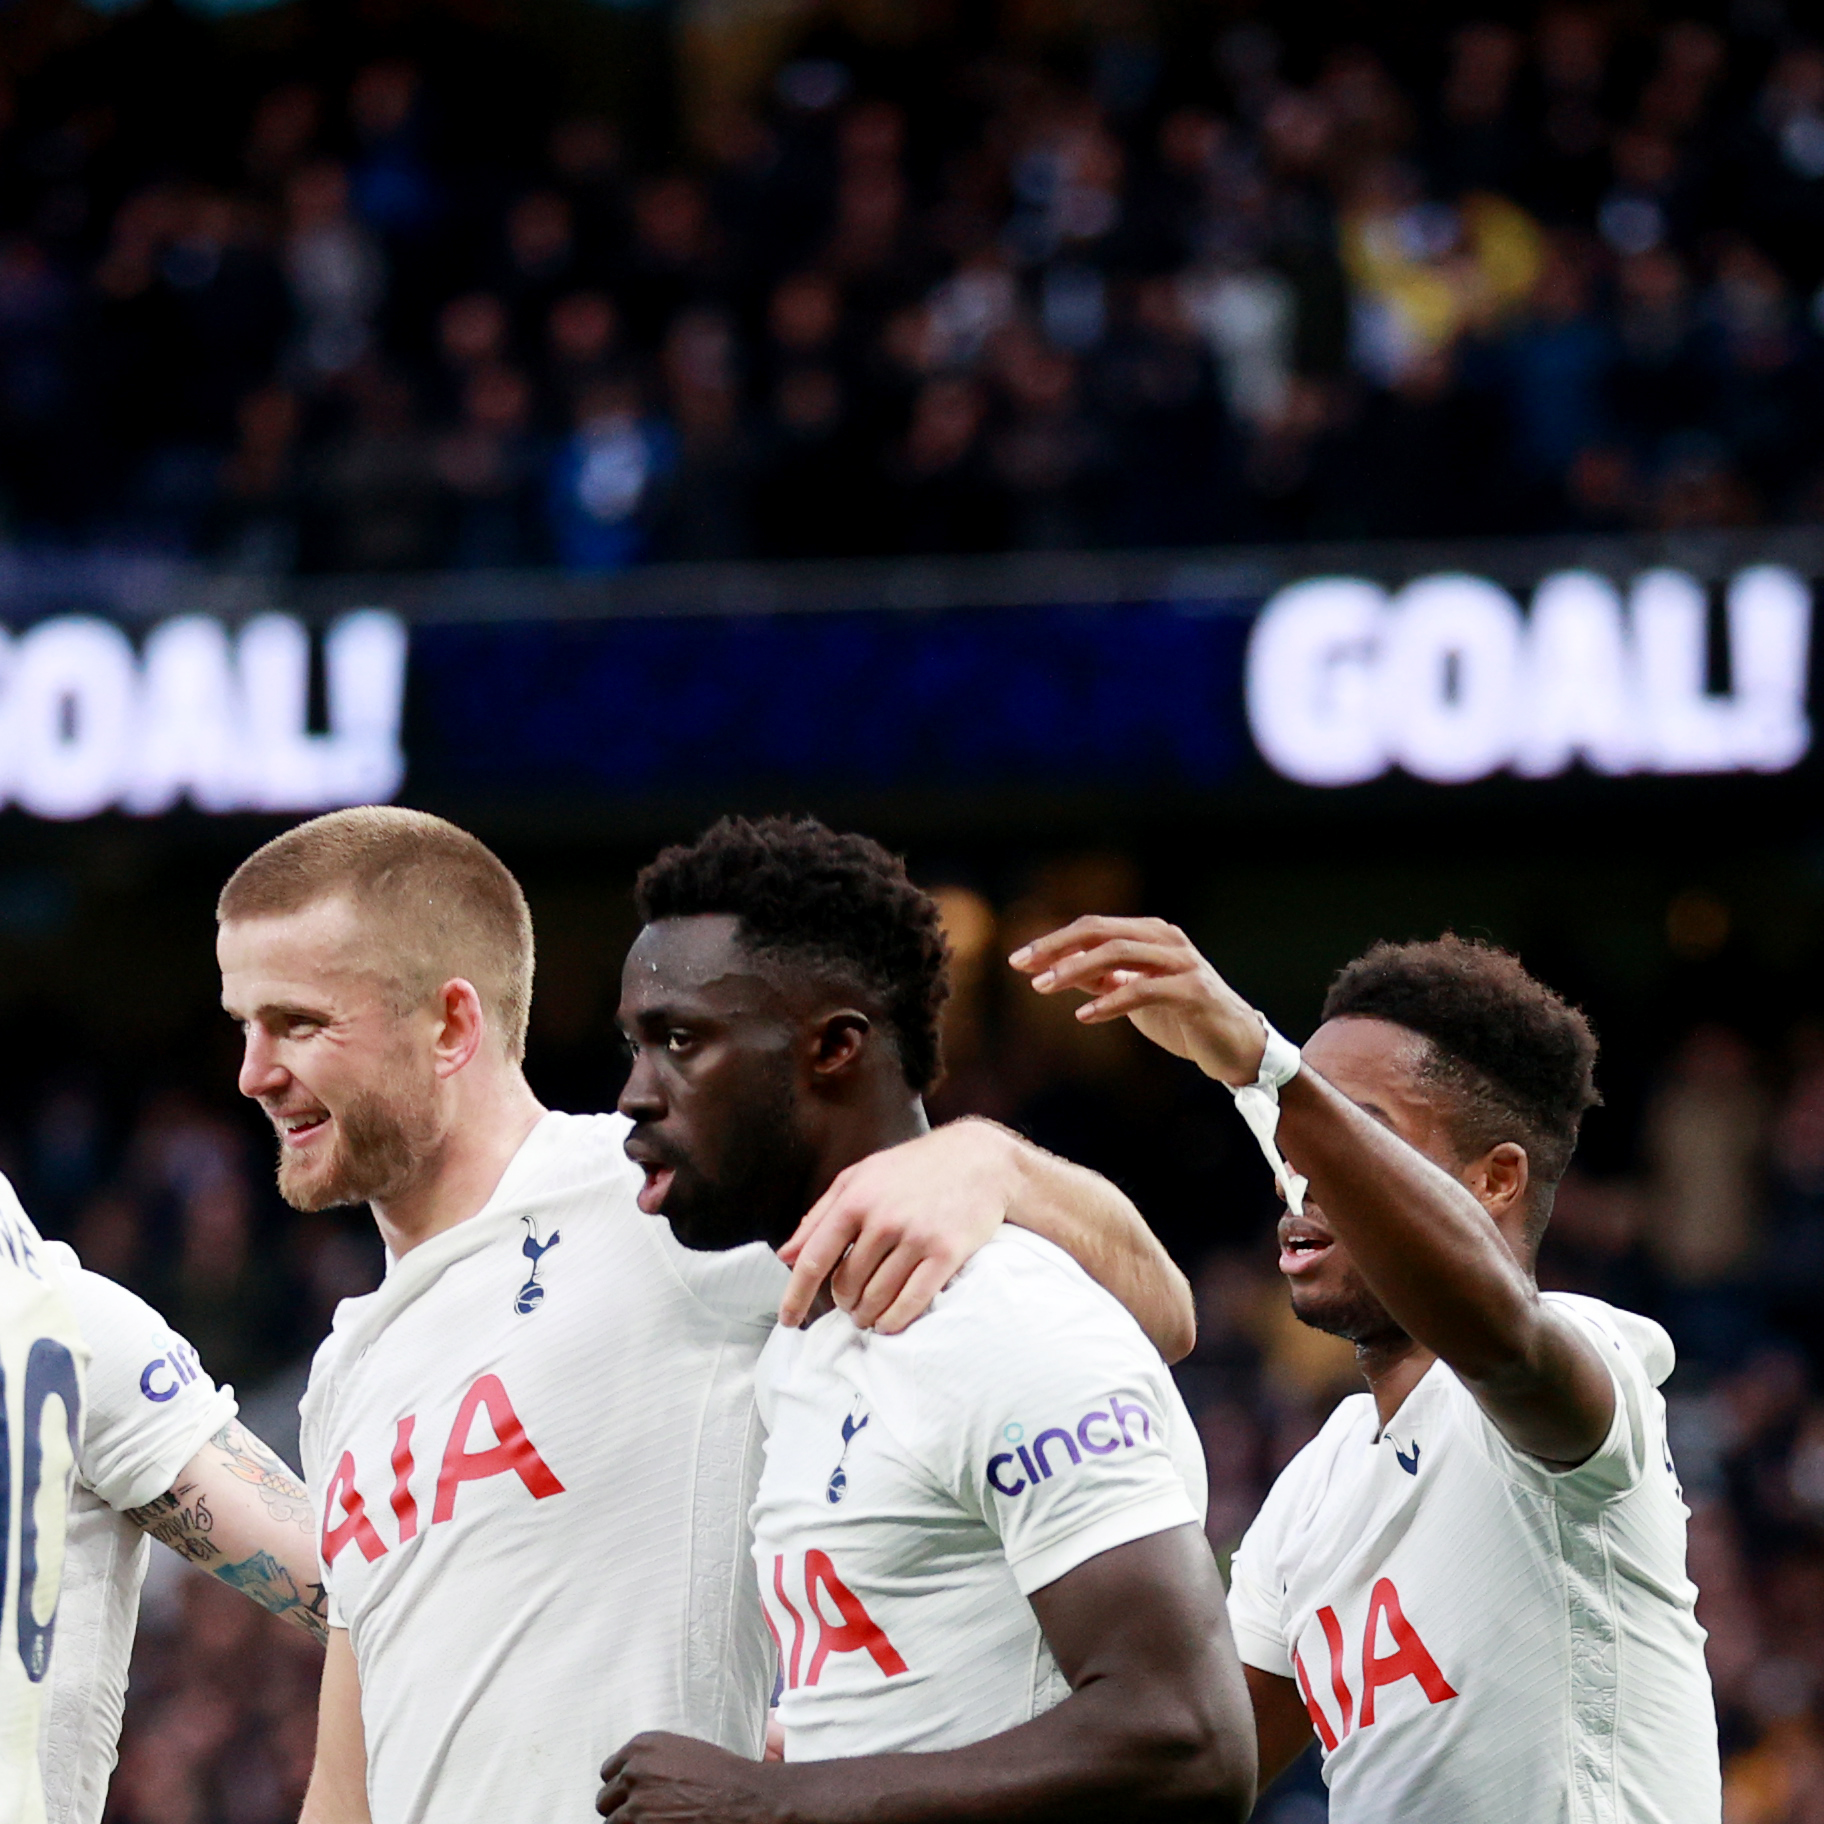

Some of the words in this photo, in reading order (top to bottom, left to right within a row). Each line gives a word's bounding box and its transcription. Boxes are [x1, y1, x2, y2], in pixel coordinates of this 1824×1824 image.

[1248, 567, 1808, 783] GOAL!
[321, 1373, 567, 1569] AIA
[986, 1396, 1150, 1497] cinch
[759, 1548, 910, 1690] IA
